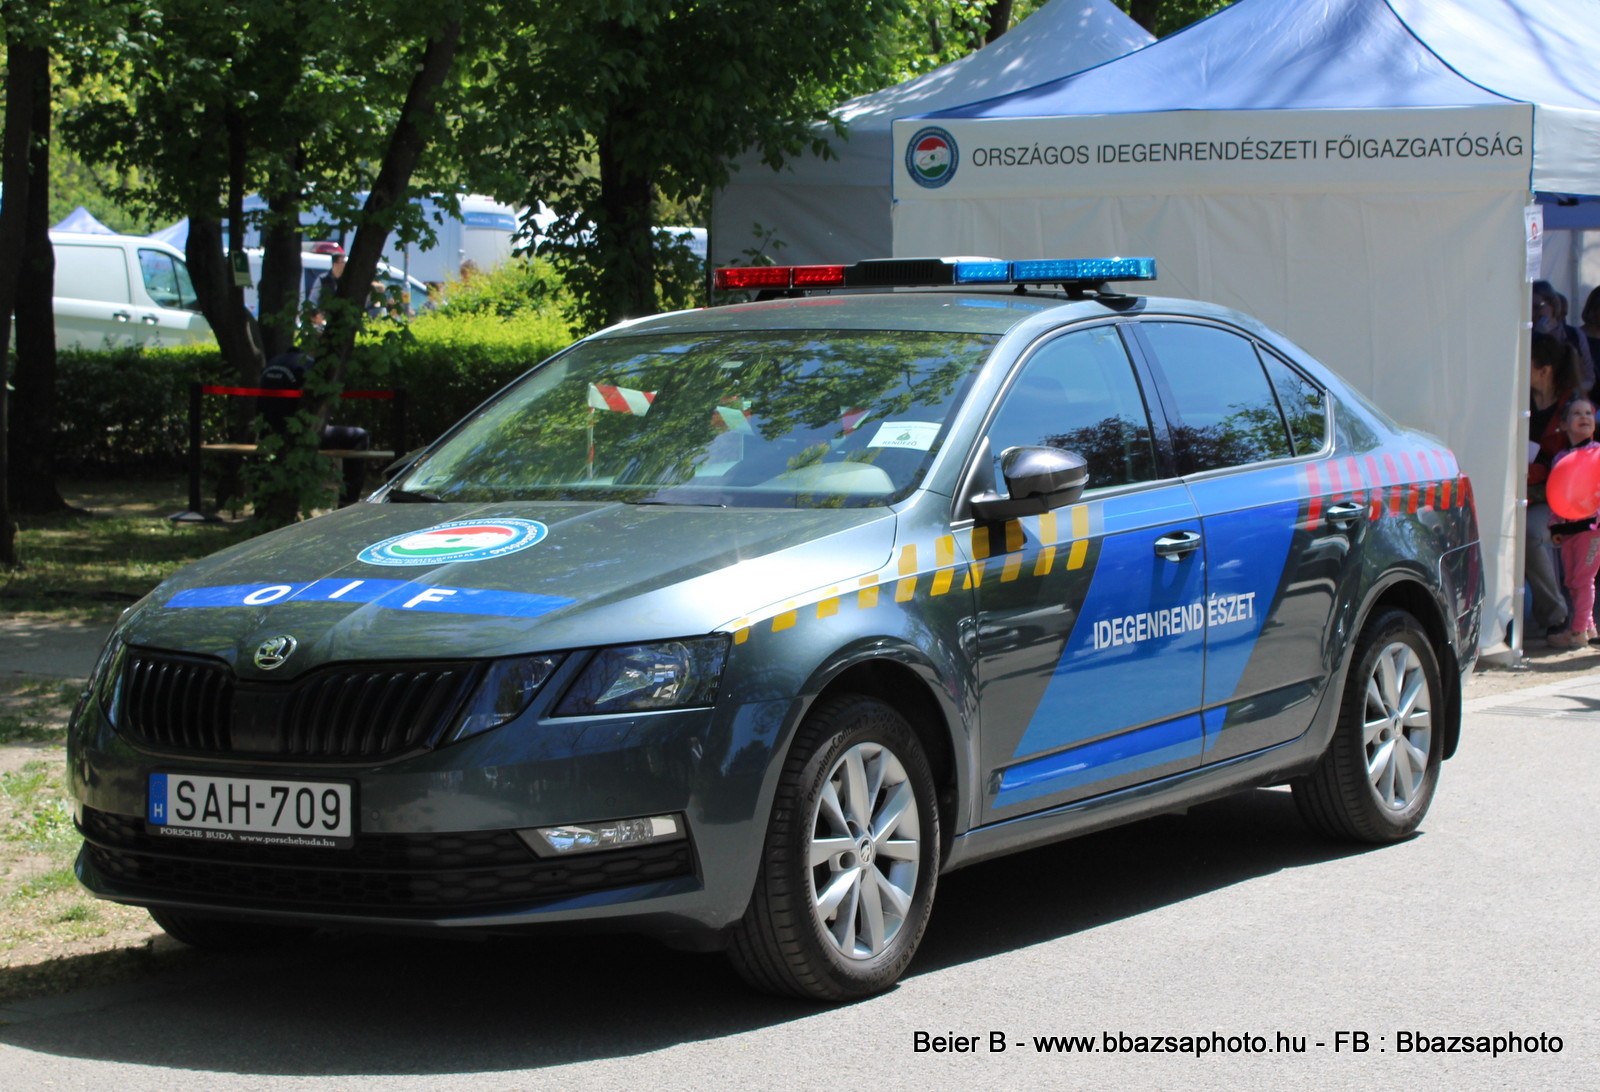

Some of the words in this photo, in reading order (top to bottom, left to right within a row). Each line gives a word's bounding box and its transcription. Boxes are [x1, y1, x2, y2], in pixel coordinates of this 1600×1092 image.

[972, 143, 1089, 167] ORSZÁGOS
[1097, 137, 1317, 163] IDEGENRENDÉSZETI
[1325, 131, 1523, 158] FŐIGAZGATÓSÁG
[1094, 592, 1255, 649] IDEGENRENDÉSZET
[154, 803, 163, 818] H
[175, 780, 341, 831] SAH-709
[160, 827, 203, 838] PORSCHE
[206, 831, 234, 841] BUDA
[239, 834, 336, 847] www.porschebuda.hu
